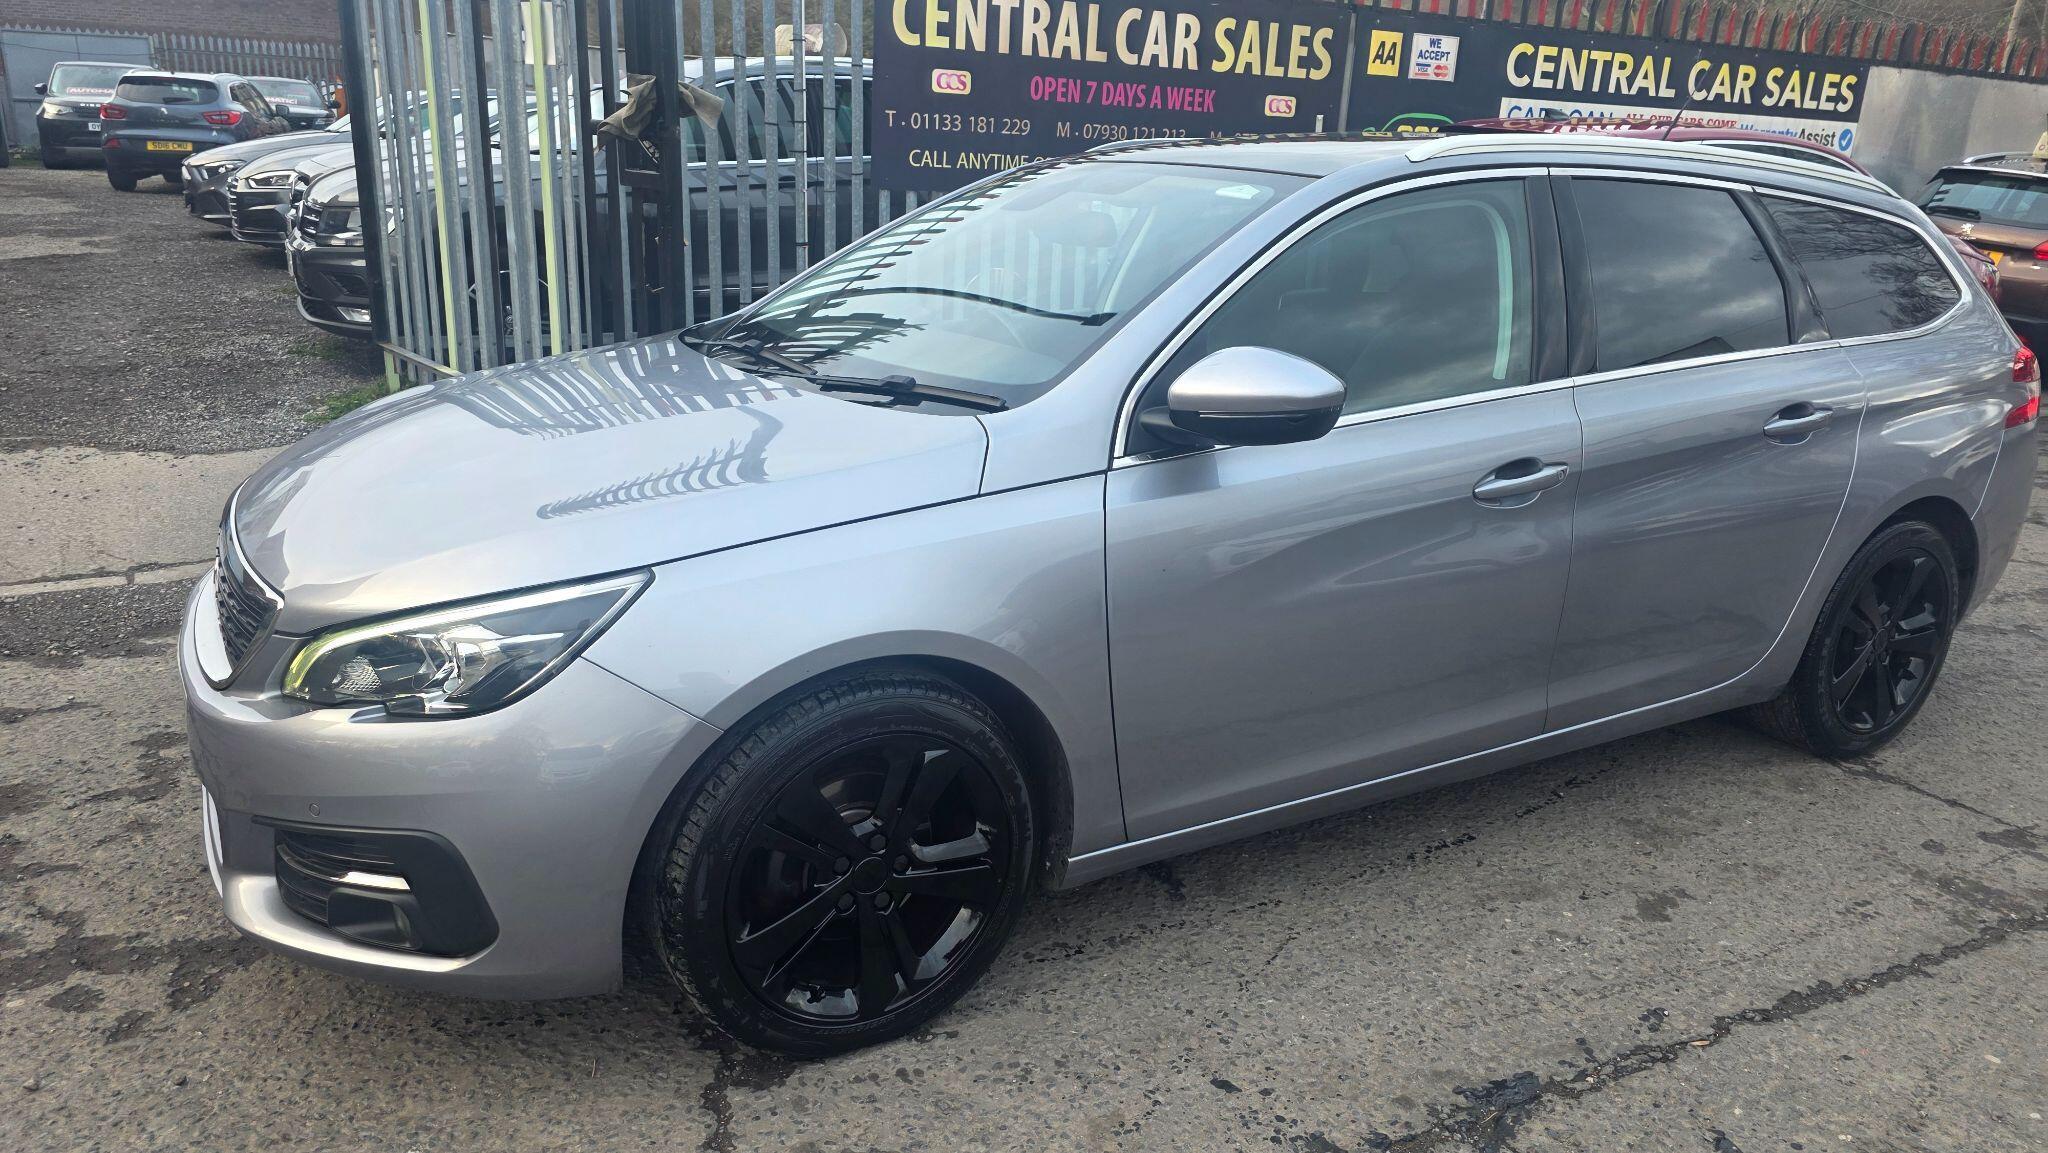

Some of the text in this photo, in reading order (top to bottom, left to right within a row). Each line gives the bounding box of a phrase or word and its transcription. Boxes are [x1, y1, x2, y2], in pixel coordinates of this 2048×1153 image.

[892, 0, 1334, 81] CENTRAL CAR SALES
[1372, 40, 1398, 65] AA
[1429, 37, 1442, 49] WE
[1417, 49, 1451, 62] ACCEPT
[1506, 42, 1858, 113] CENTRAL CAR SALES
[1030, 75, 1217, 113] OPEN 7 DAYS A WEEK
[910, 112, 962, 132] 01133
[969, 116, 995, 134] 181
[1001, 118, 1031, 136] 229
[1083, 123, 1127, 141] 07930
[909, 149, 951, 169] CALL
